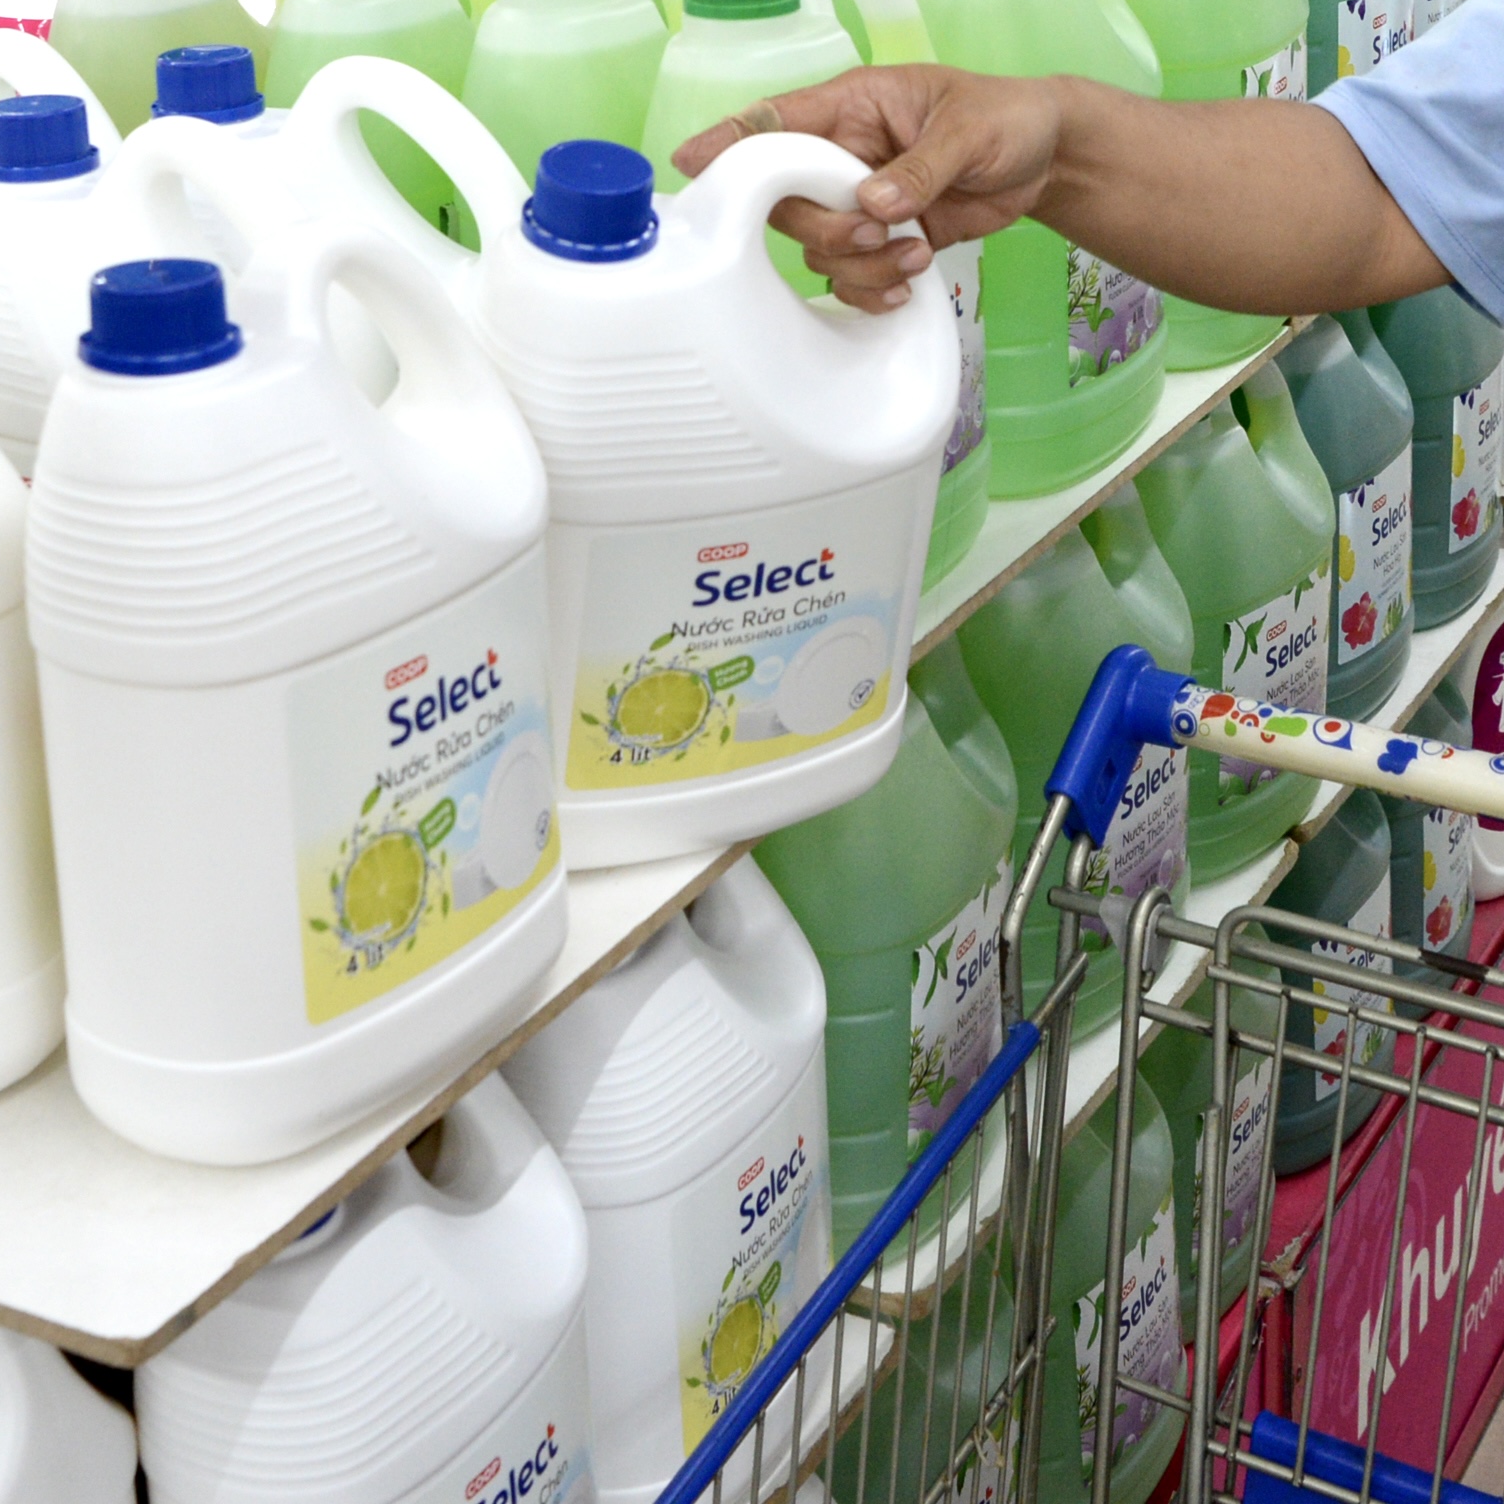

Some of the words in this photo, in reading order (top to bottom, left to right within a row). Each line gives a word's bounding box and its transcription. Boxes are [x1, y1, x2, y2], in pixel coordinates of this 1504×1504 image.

[699, 545, 747, 562] COOP
[692, 548, 835, 608] Select
[670, 618, 734, 640] Nước
[742, 606, 786, 629] Rửa
[794, 590, 846, 617] Chén
[687, 640, 718, 652] DISH
[723, 627, 784, 647] WASHING
[788, 613, 828, 633] LIQUID
[1267, 621, 1287, 641] COOP
[1266, 616, 1317, 677] Select
[386, 658, 428, 688] COOP
[388, 647, 502, 748] Select
[376, 753, 431, 793] Nước
[436, 728, 472, 764] Rửa
[476, 699, 515, 738] Chén
[610, 751, 622, 764] 4
[631, 746, 652, 764] lít
[1147, 807, 1162, 828] Lau
[1114, 841, 1146, 871] Hương
[1147, 820, 1165, 843] Thảo
[346, 954, 358, 975] 4
[739, 1157, 764, 1191] COOP
[740, 1135, 806, 1235] Select
[732, 1232, 767, 1270] Nước
[769, 1205, 790, 1237] Rửa
[791, 1169, 813, 1208] Chén
[711, 1399, 720, 1416] 4
